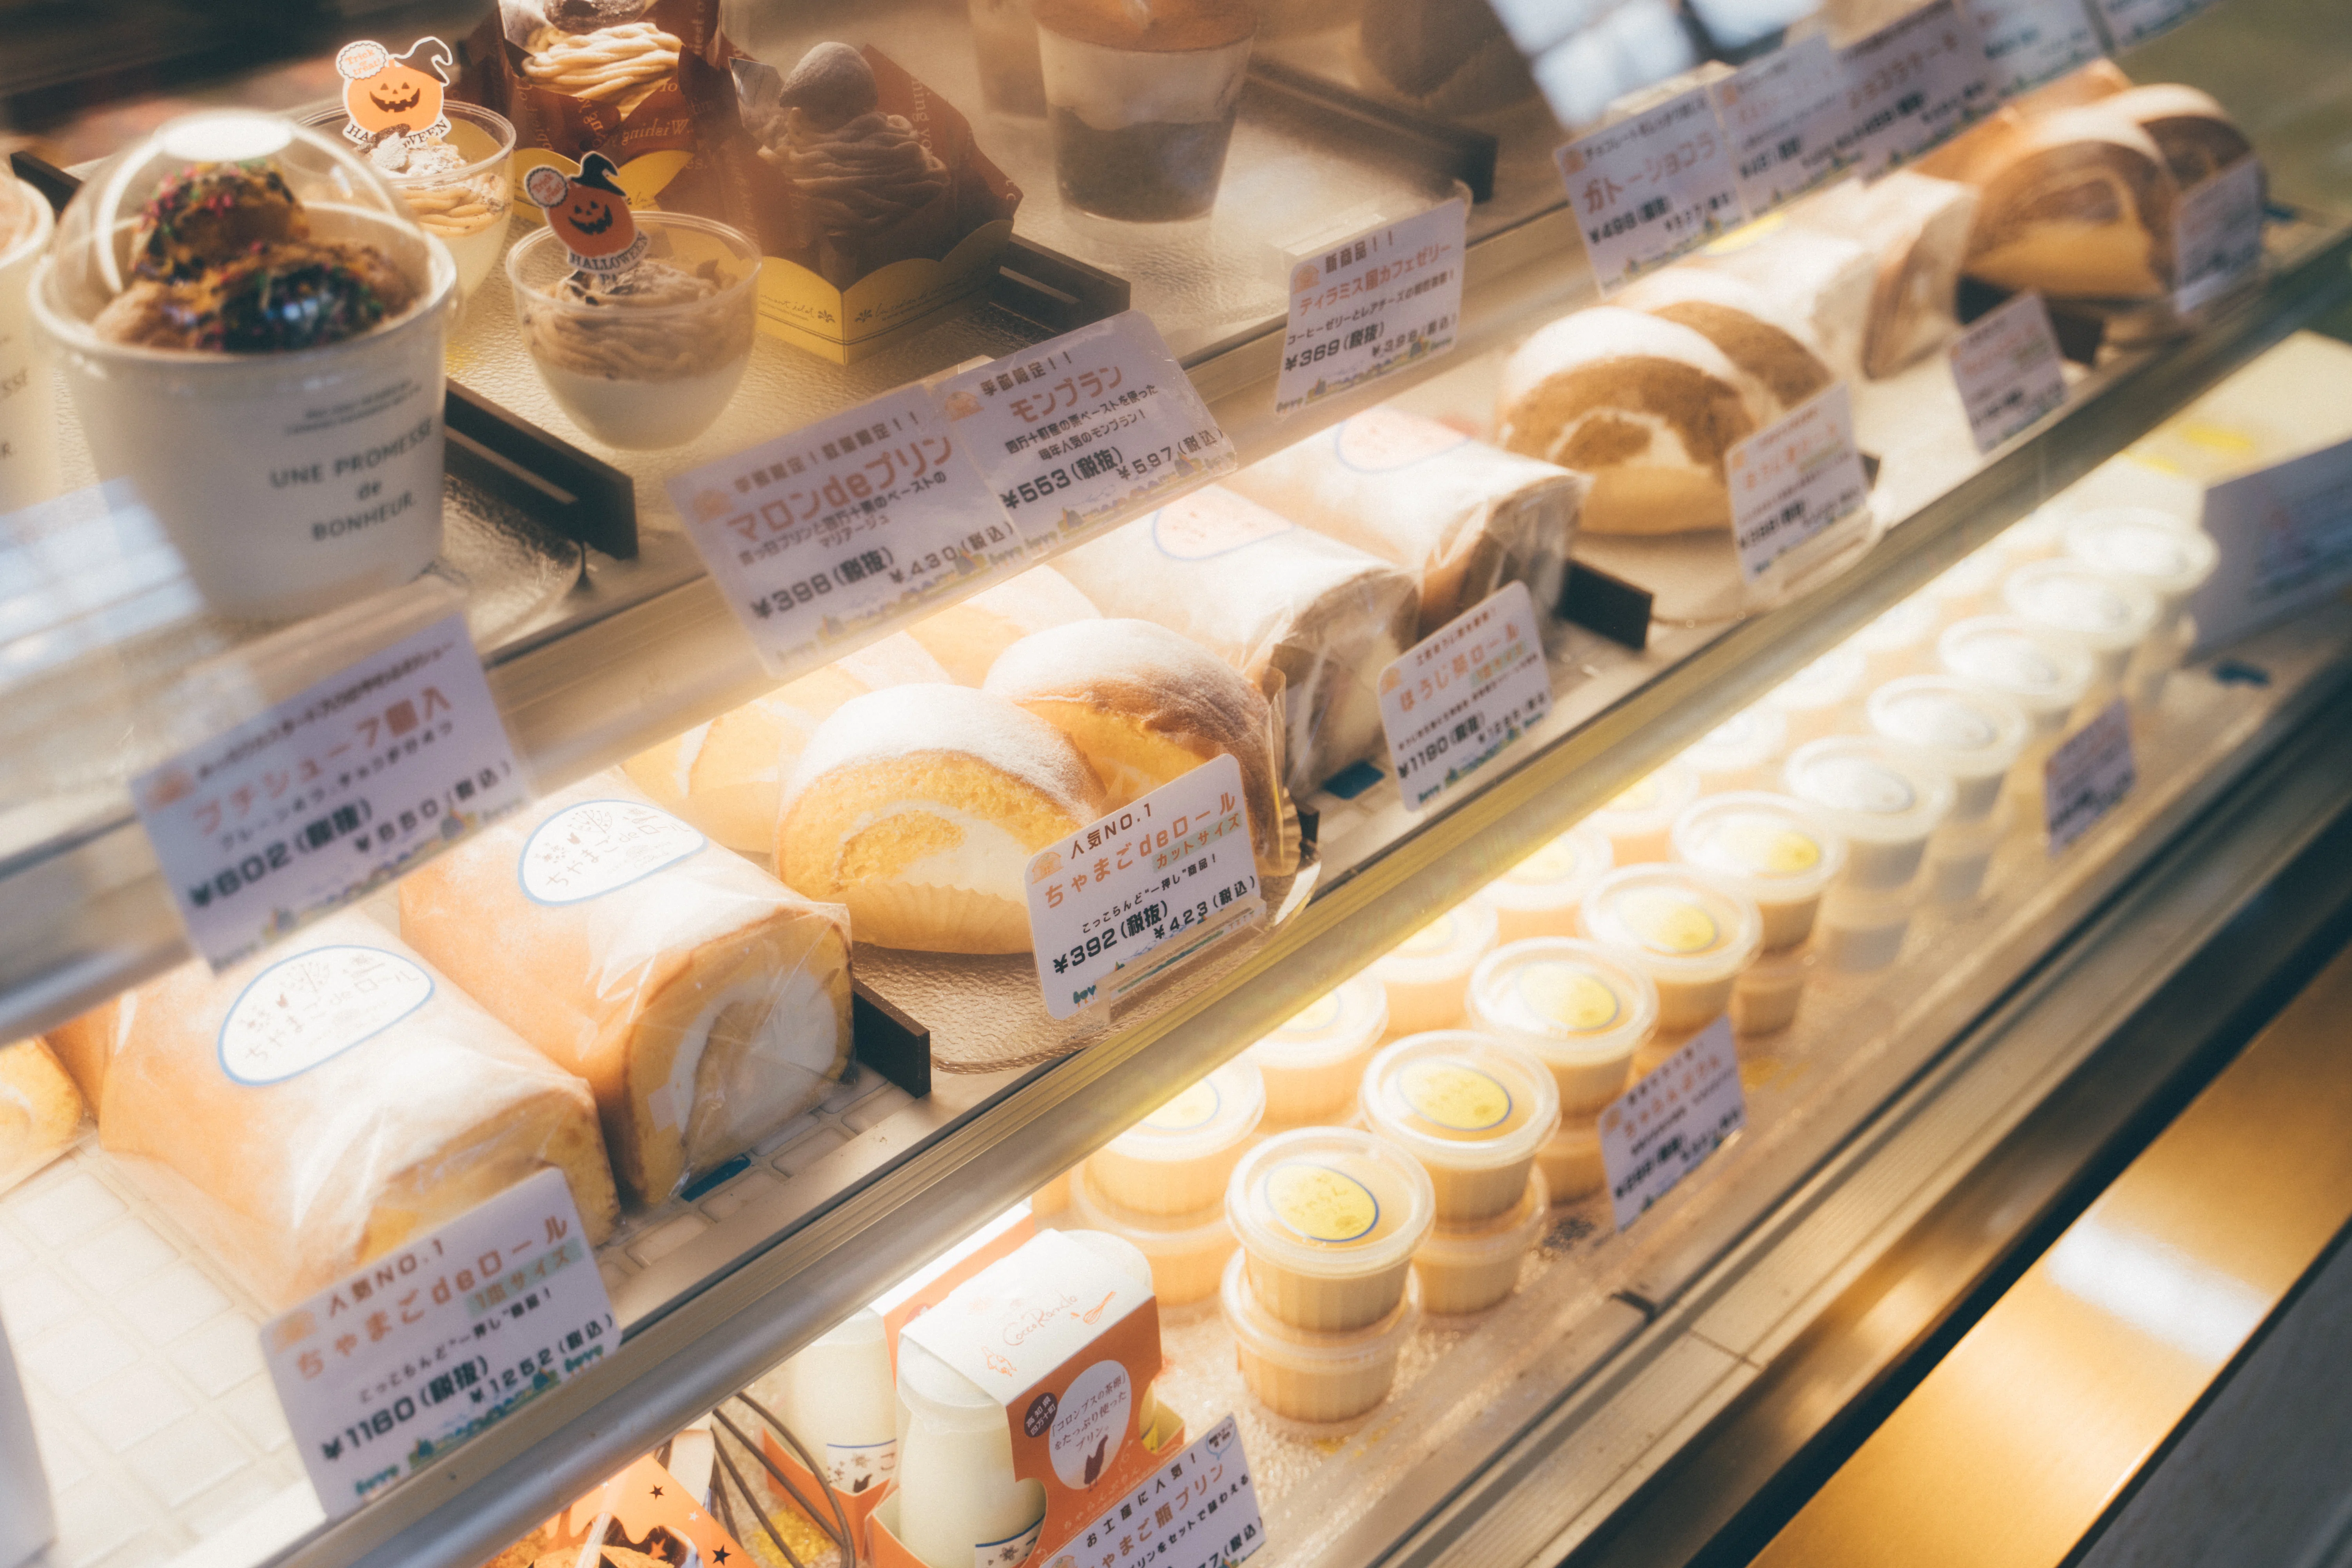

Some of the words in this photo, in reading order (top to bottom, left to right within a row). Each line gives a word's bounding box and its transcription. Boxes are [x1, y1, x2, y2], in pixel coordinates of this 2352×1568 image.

[345, 49, 375, 65] Trick
[347, 120, 448, 148] HAWEEN
[570, 231, 648, 270] HALLOWEEN
[1010, 367, 1123, 423] モンブラン
[271, 464, 321, 488] UNE
[333, 418, 431, 477] PROMESSE
[311, 491, 414, 540] BONHEUR
[726, 437, 952, 542] マロンdeプリン
[1045, 792, 1236, 908] ちゃまごdeロール
[1071, 803, 1151, 859] 人気NO.1
[1157, 813, 1241, 869] カットサイズ
[296, 1215, 568, 1379] ちゃまごdeロール
[328, 1237, 445, 1318] 人気NO.1
[1026, 1395, 1052, 1428] 高知県
[1030, 1403, 1056, 1436] 四万十町
[1054, 1391, 1127, 1450] をたっぷり使った
[1086, 1453, 1196, 1548] お土産に人気！
[1090, 1464, 1223, 1568] ゃまご瓶プリン
